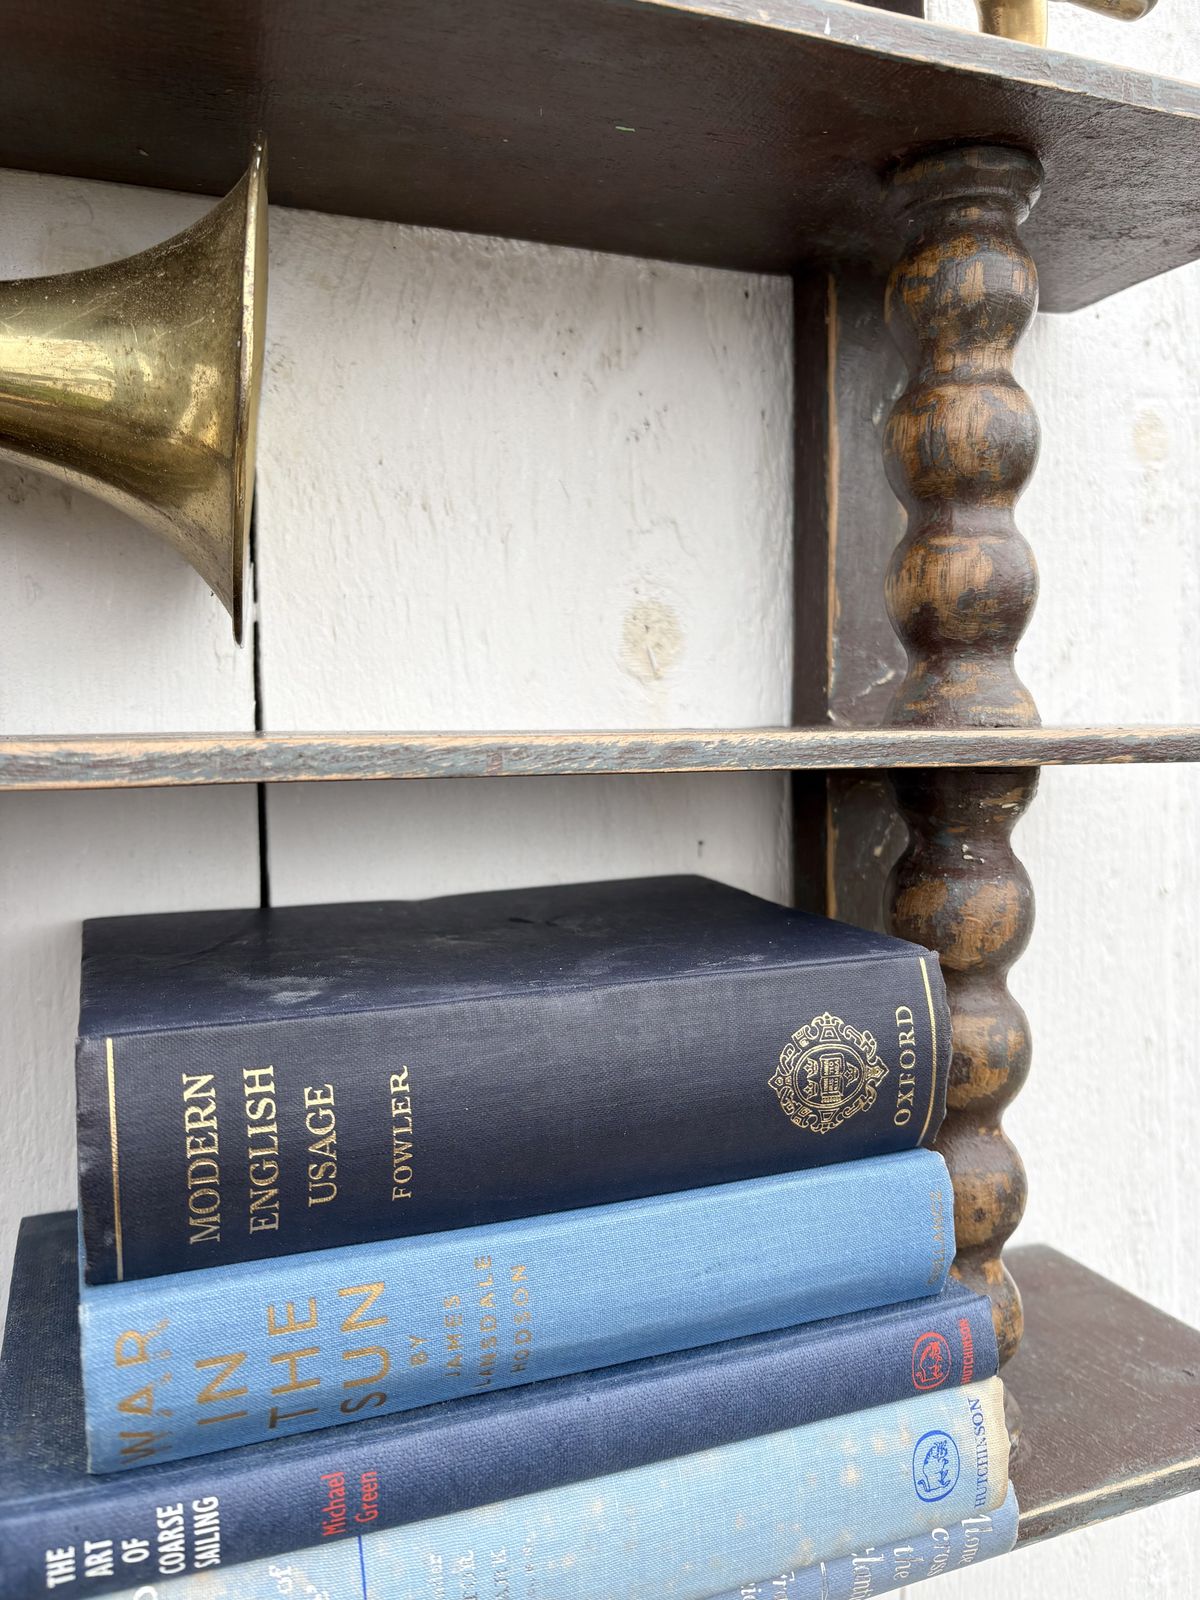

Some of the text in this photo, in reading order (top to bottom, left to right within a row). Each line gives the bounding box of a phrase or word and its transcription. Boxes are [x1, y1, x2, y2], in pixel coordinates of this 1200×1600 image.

[894, 1005, 916, 1126] OXFORD
[182, 1072, 221, 1245] MODERN
[243, 1064, 279, 1235] ENGLISH
[304, 1083, 339, 1207] USAGE
[389, 1065, 414, 1201] FOWLER
[338, 1281, 392, 1414] SUN
[409, 1334, 429, 1367] BY
[444, 1294, 464, 1378] JAMES
[474, 1255, 499, 1388] LANSDALE
[510, 1264, 534, 1374] HODSON
[958, 1318, 974, 1385] HUTCHINSON
[114, 1318, 171, 1465] WAR
[195, 1350, 249, 1426] IN
[267, 1297, 321, 1429] THE
[968, 1397, 990, 1509] HUTCHINSON
[191, 1495, 221, 1569] SAILING
[321, 1471, 346, 1537] Michael
[355, 1470, 379, 1523] Green
[46, 1545, 76, 1588] THE
[84, 1539, 114, 1577] ART
[121, 1538, 150, 1563] OF
[156, 1502, 186, 1574] COARSE
[893, 1544, 925, 1581] the
[927, 1527, 950, 1577] cross
